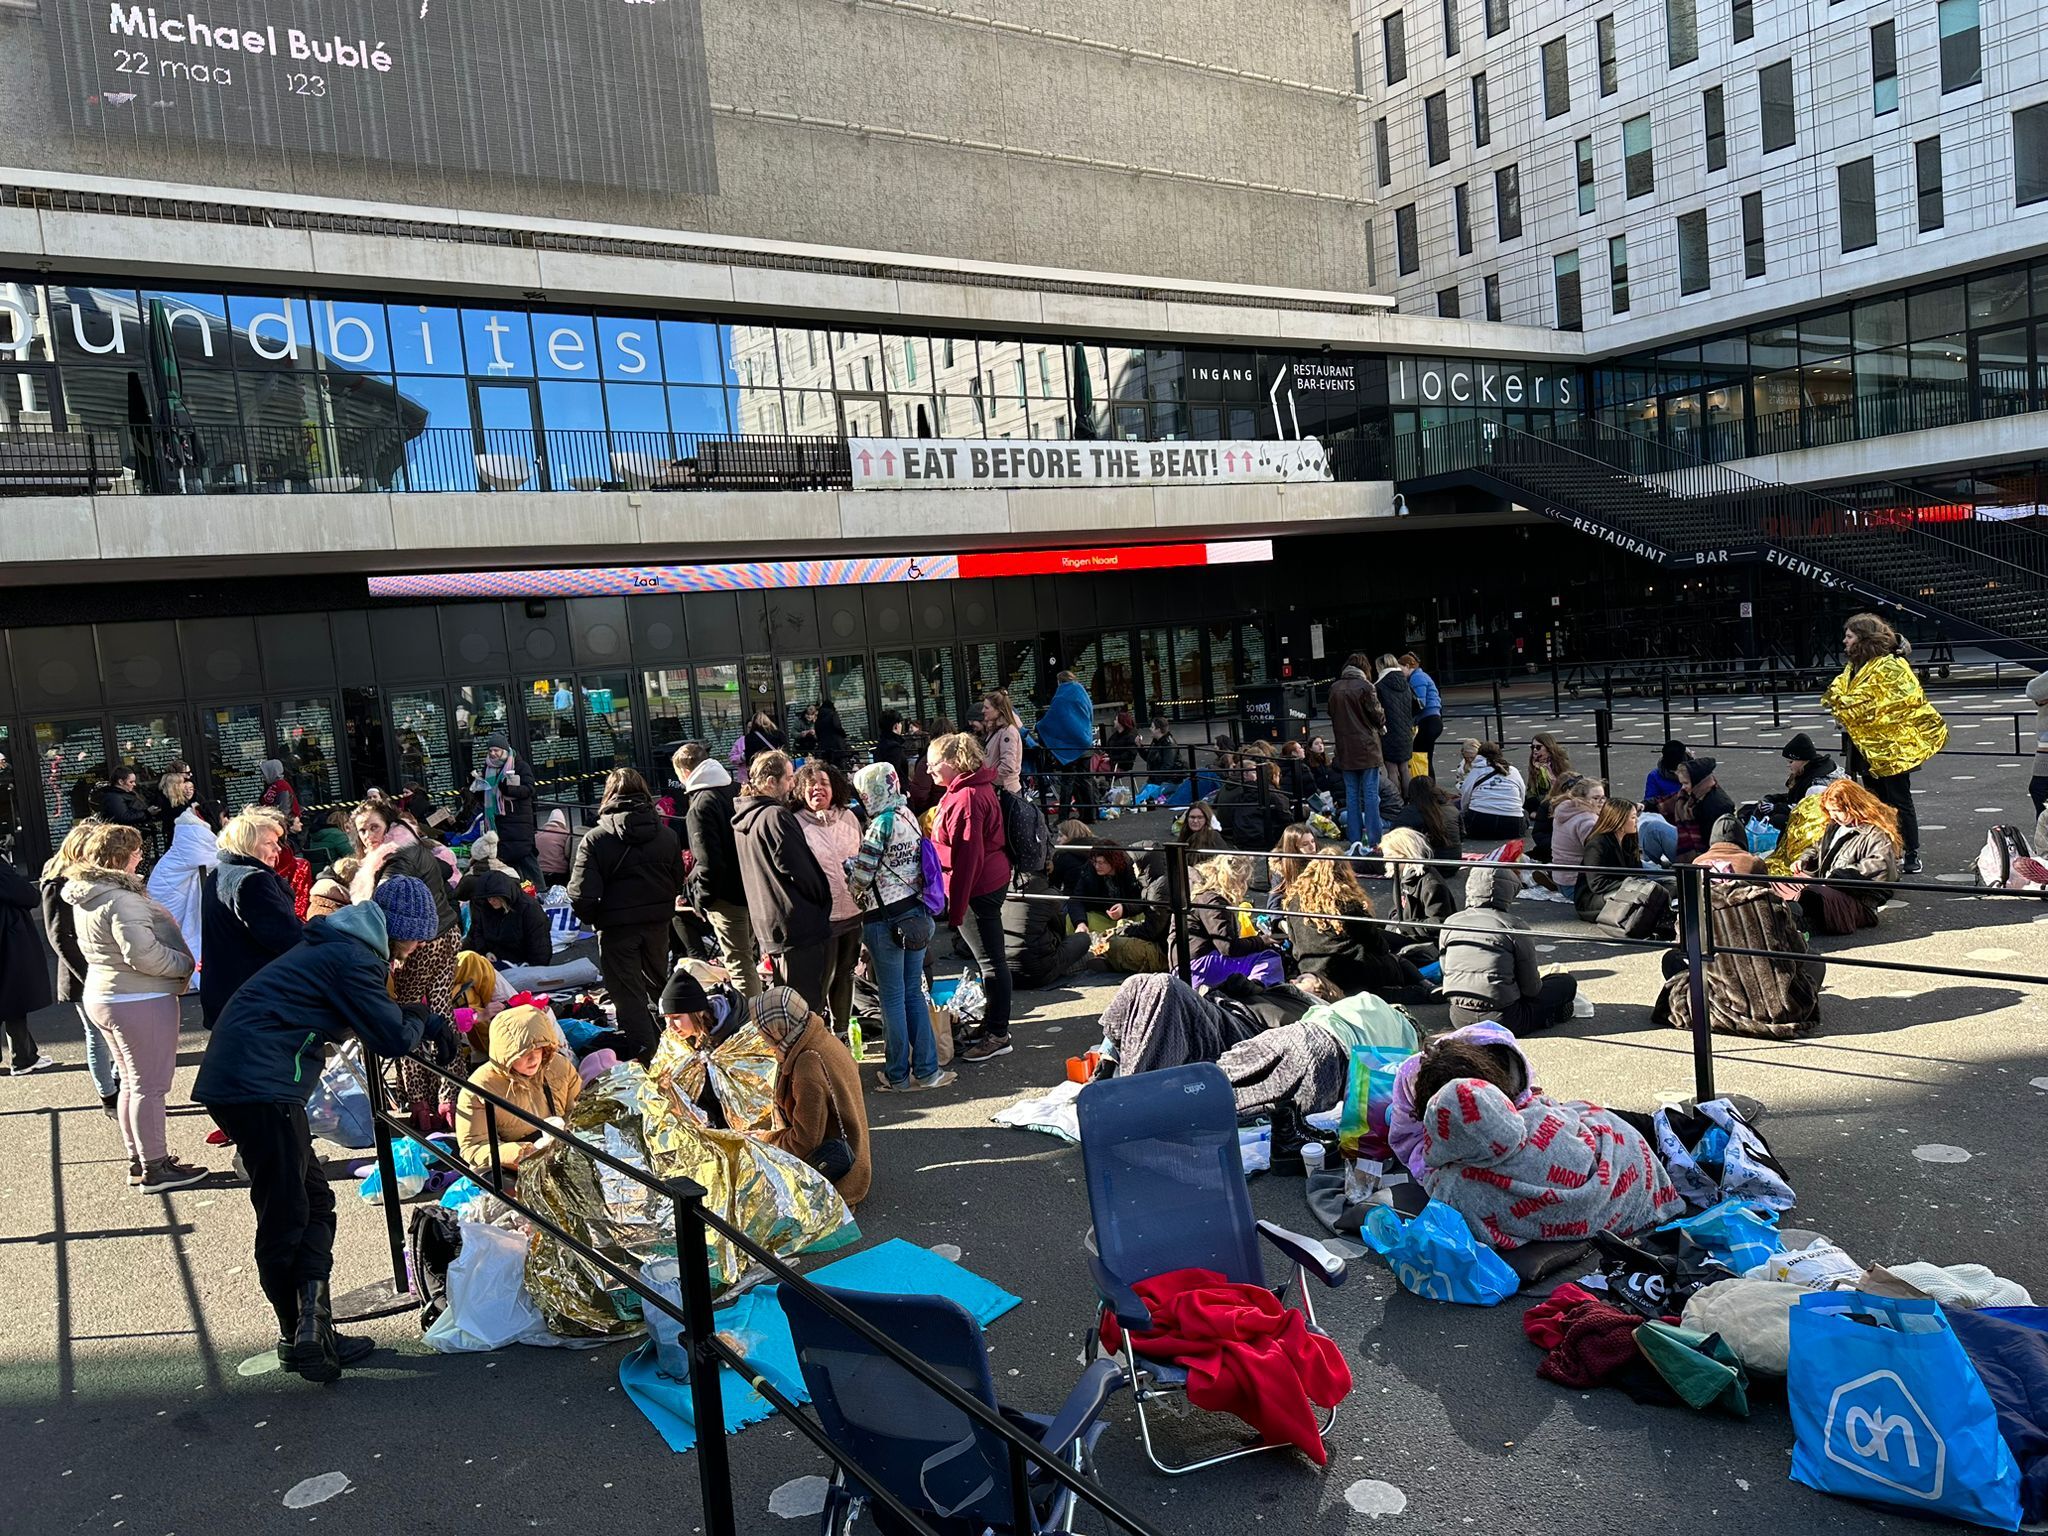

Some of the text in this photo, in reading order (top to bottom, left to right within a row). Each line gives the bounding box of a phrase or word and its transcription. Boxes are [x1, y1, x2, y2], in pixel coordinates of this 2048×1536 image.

[109, 2, 392, 72] Michael Bublé
[113, 49, 150, 75] 22
[1192, 367, 1253, 381] INGANG
[1293, 364, 1355, 377] RESTAURANT
[1297, 378, 1356, 391] BAR-EVENTS
[1399, 360, 1571, 405] lockers
[903, 447, 1219, 480] EAT BEFORE THE BEAT!
[1061, 557, 1092, 569] Ringen
[1572, 516, 1833, 585] RESTAURANT BAR EVENTS
[633, 575, 660, 587] Zaal
[1530, 1114, 1565, 1152] MARVEL
[1545, 1163, 1588, 1190] MARV
[1610, 1162, 1640, 1201] MARVEL
[1509, 1188, 1564, 1220] MARVEL
